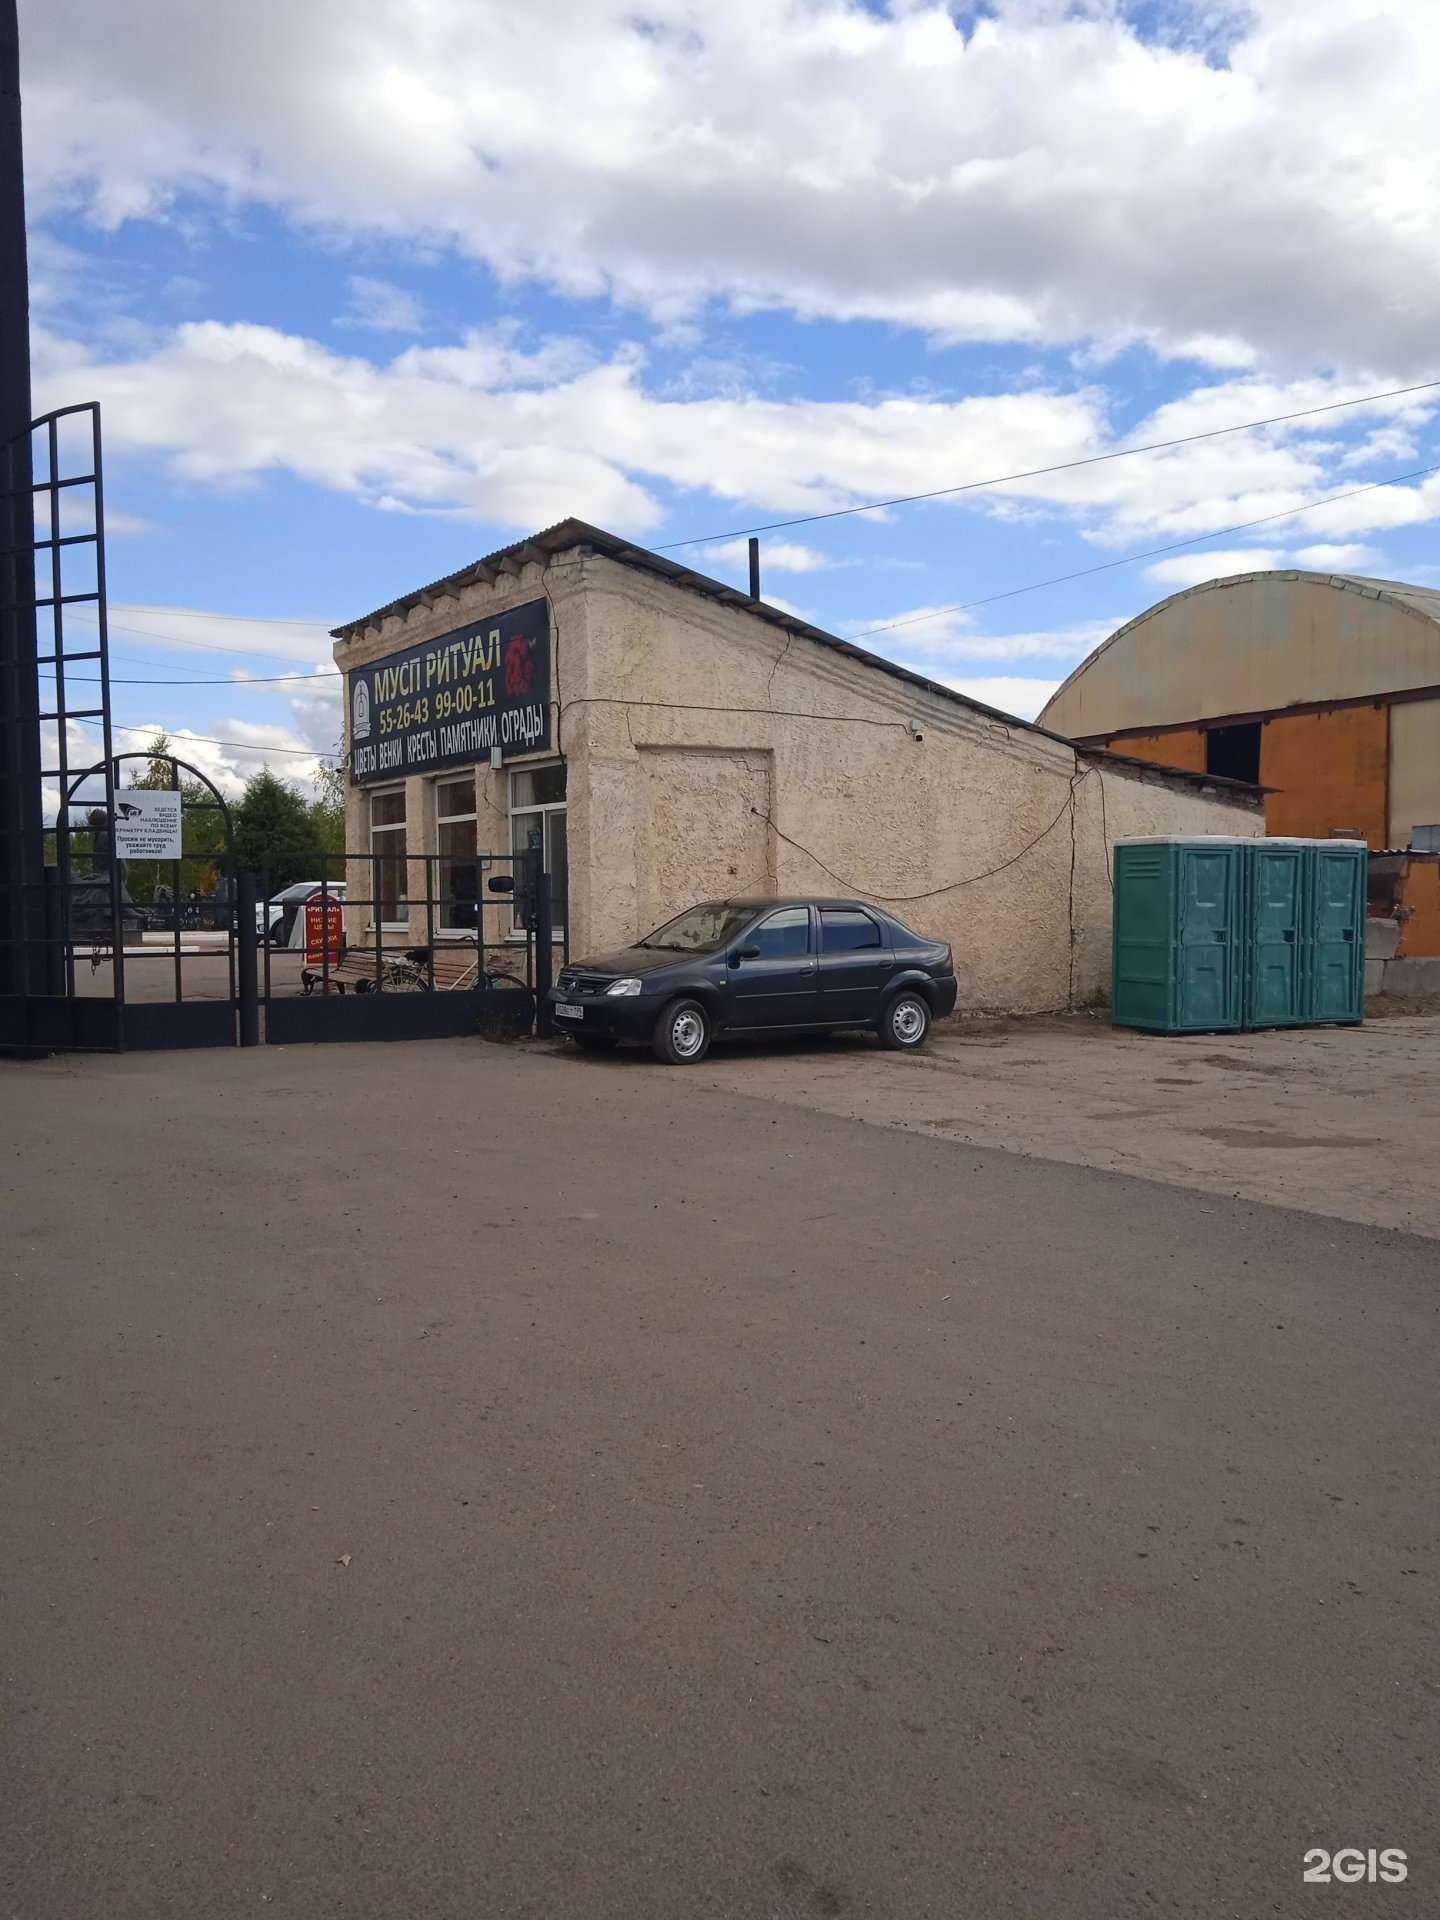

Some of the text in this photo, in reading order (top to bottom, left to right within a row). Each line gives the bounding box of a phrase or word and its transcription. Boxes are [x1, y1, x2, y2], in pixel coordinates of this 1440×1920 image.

[374, 629, 500, 705] МУСП РИТУАЛ
[379, 678, 496, 735] 55-26-43 99-00-11
[354, 703, 544, 780] ЦВЕТЫ ВЕНКИ КРЕСТЫ ПАМЯТНИКИ ОГРАДЫ
[311, 935, 338, 945] СКИКИ
